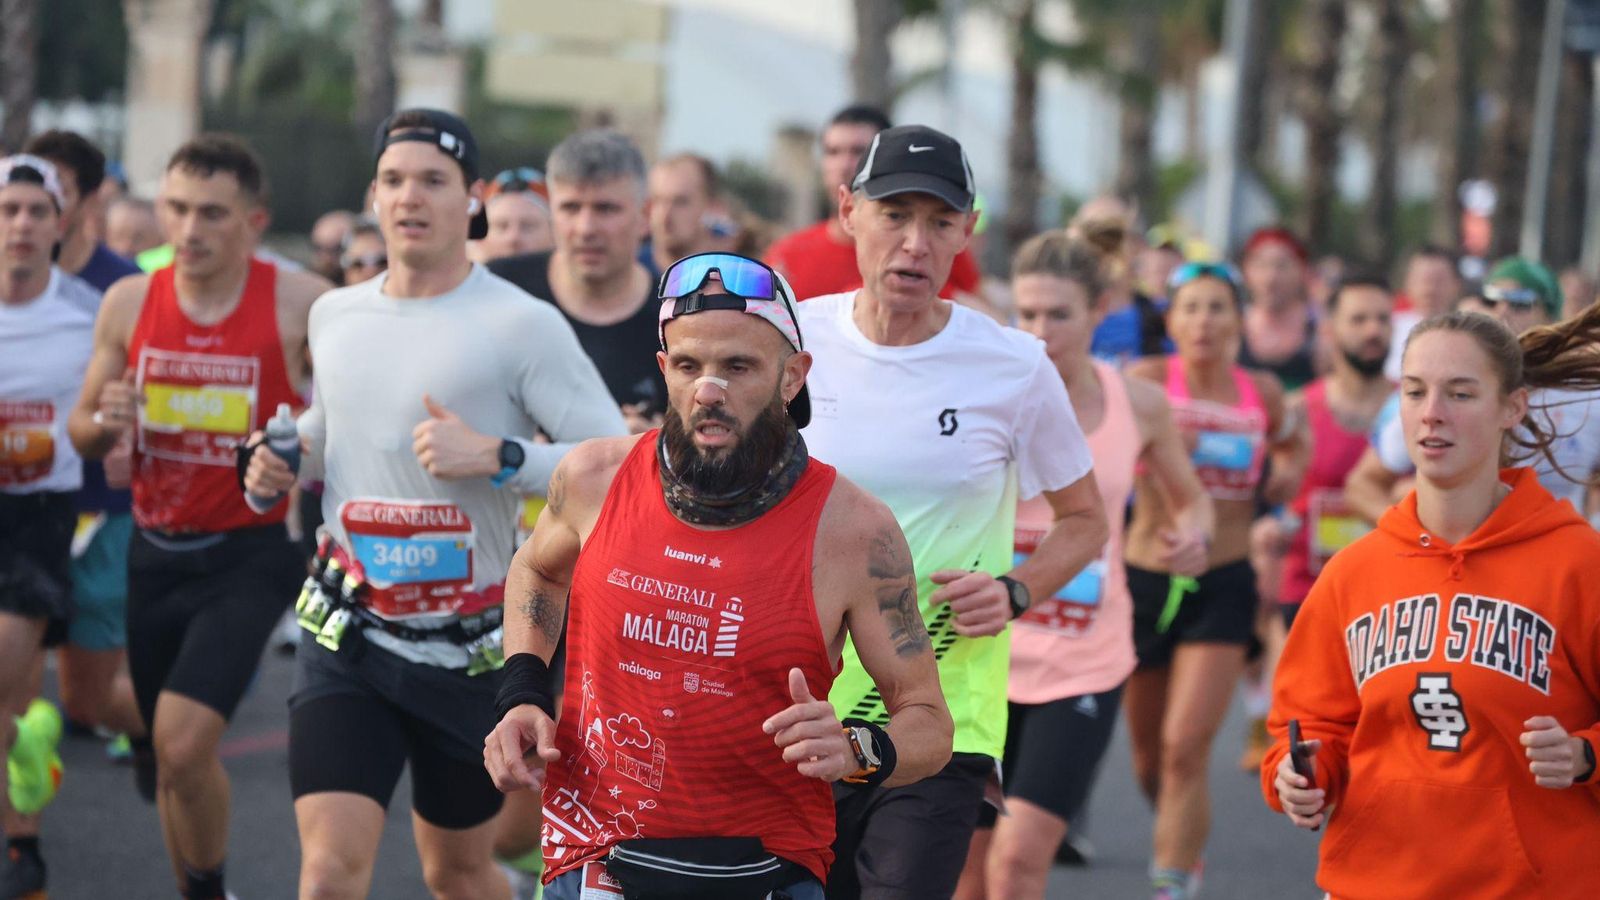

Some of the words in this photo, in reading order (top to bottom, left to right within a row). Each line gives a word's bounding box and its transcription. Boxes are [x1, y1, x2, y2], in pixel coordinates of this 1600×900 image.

[374, 506, 464, 526] GENERALI
[373, 543, 437, 567] 3409
[664, 545, 706, 565] luanvi
[631, 574, 716, 609] GENERALI
[666, 609, 709, 629] MARATÓN
[622, 612, 707, 655] MÁLAGA
[1346, 593, 1440, 692] IDAHO
[1445, 593, 1556, 696] STATE
[702, 679, 725, 689] Ciudad
[711, 687, 733, 698] Málaga
